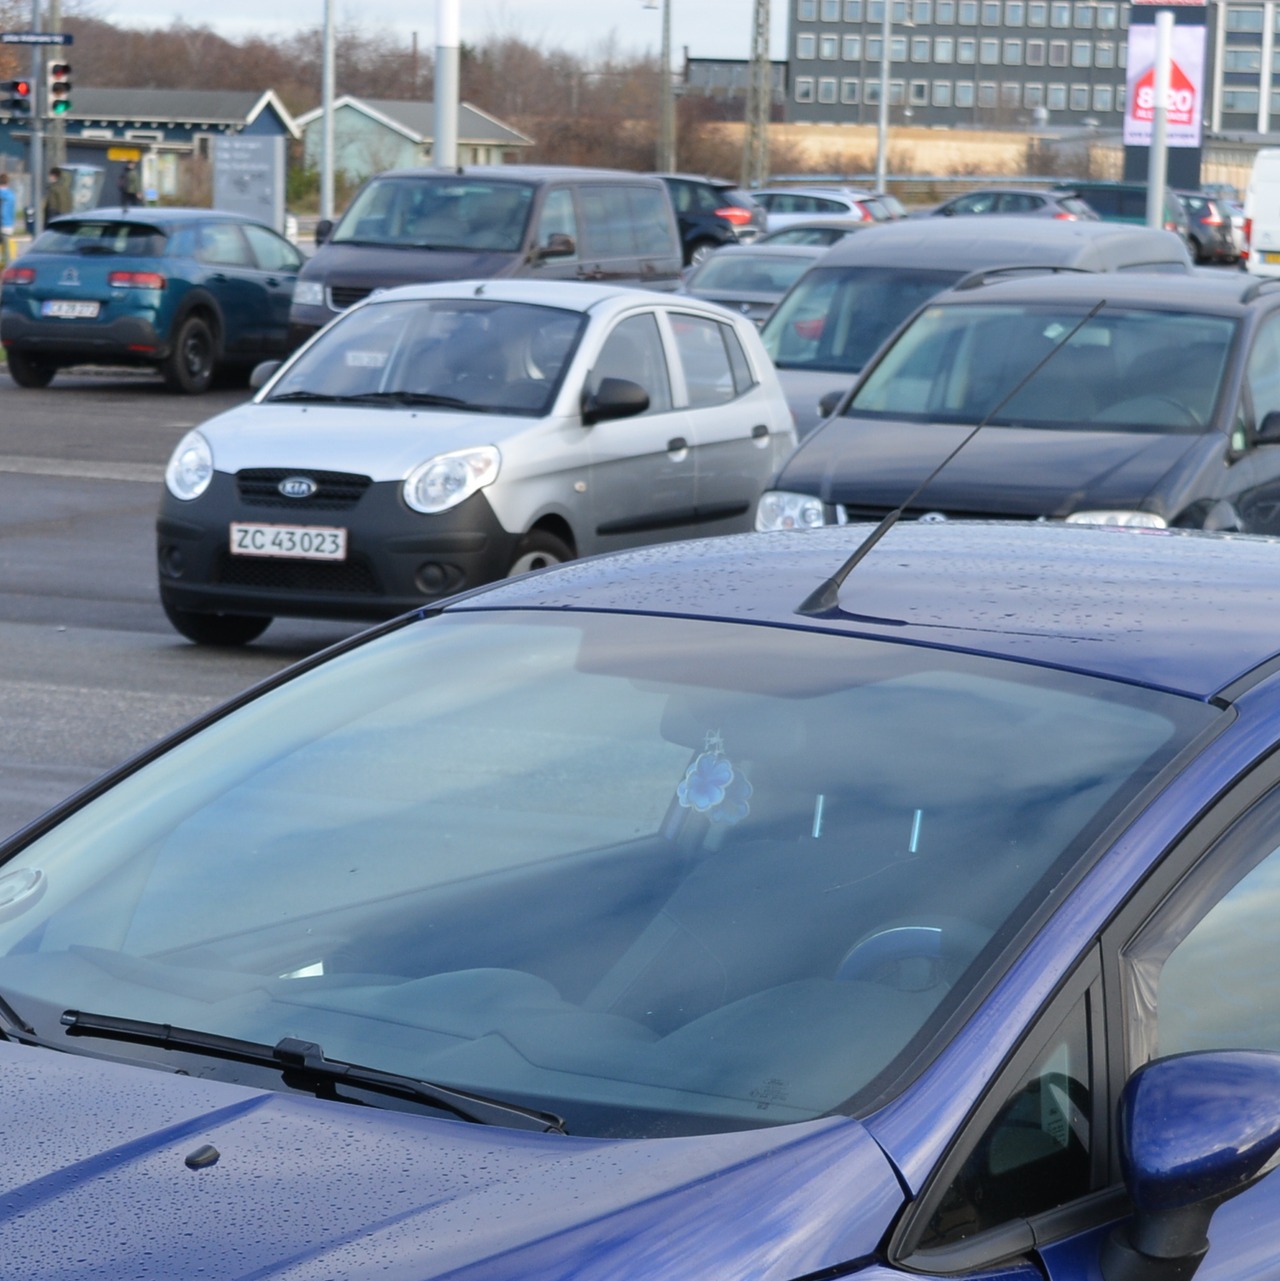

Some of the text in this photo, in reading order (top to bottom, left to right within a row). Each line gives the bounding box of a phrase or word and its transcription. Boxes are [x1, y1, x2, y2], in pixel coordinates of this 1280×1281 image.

[283, 482, 312, 495] KIA
[236, 528, 341, 554] ZC 43 023
